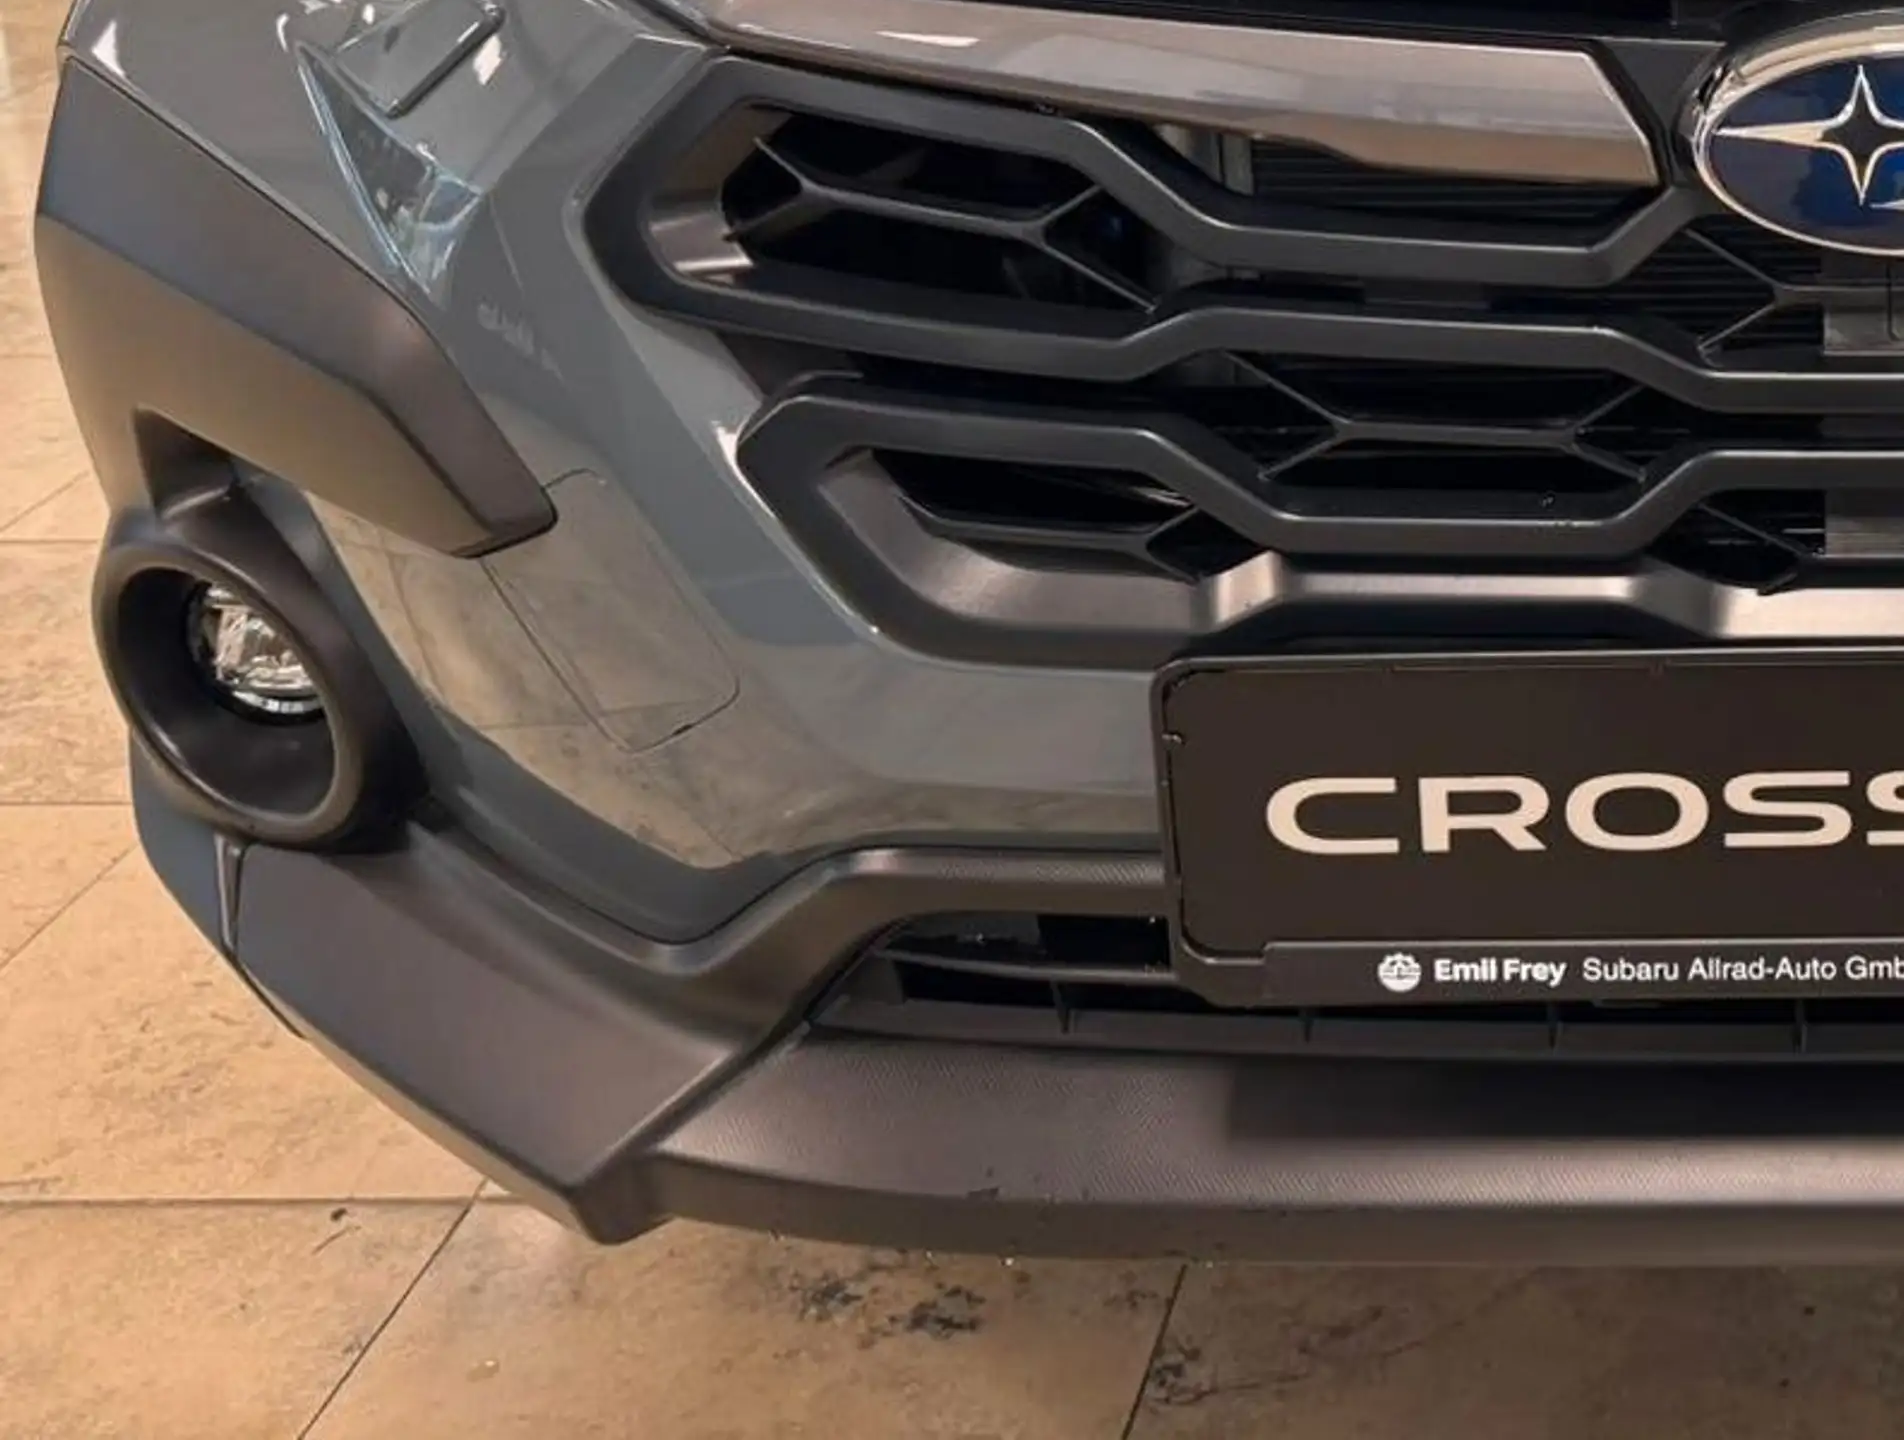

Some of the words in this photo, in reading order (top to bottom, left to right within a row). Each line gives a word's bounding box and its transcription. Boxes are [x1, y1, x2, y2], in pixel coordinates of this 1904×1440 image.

[1434, 957, 1498, 982] Emil
[1502, 957, 1567, 988] Frey
[1582, 957, 1679, 982] Subaru
[1687, 956, 1838, 981] Allrad-Auto
